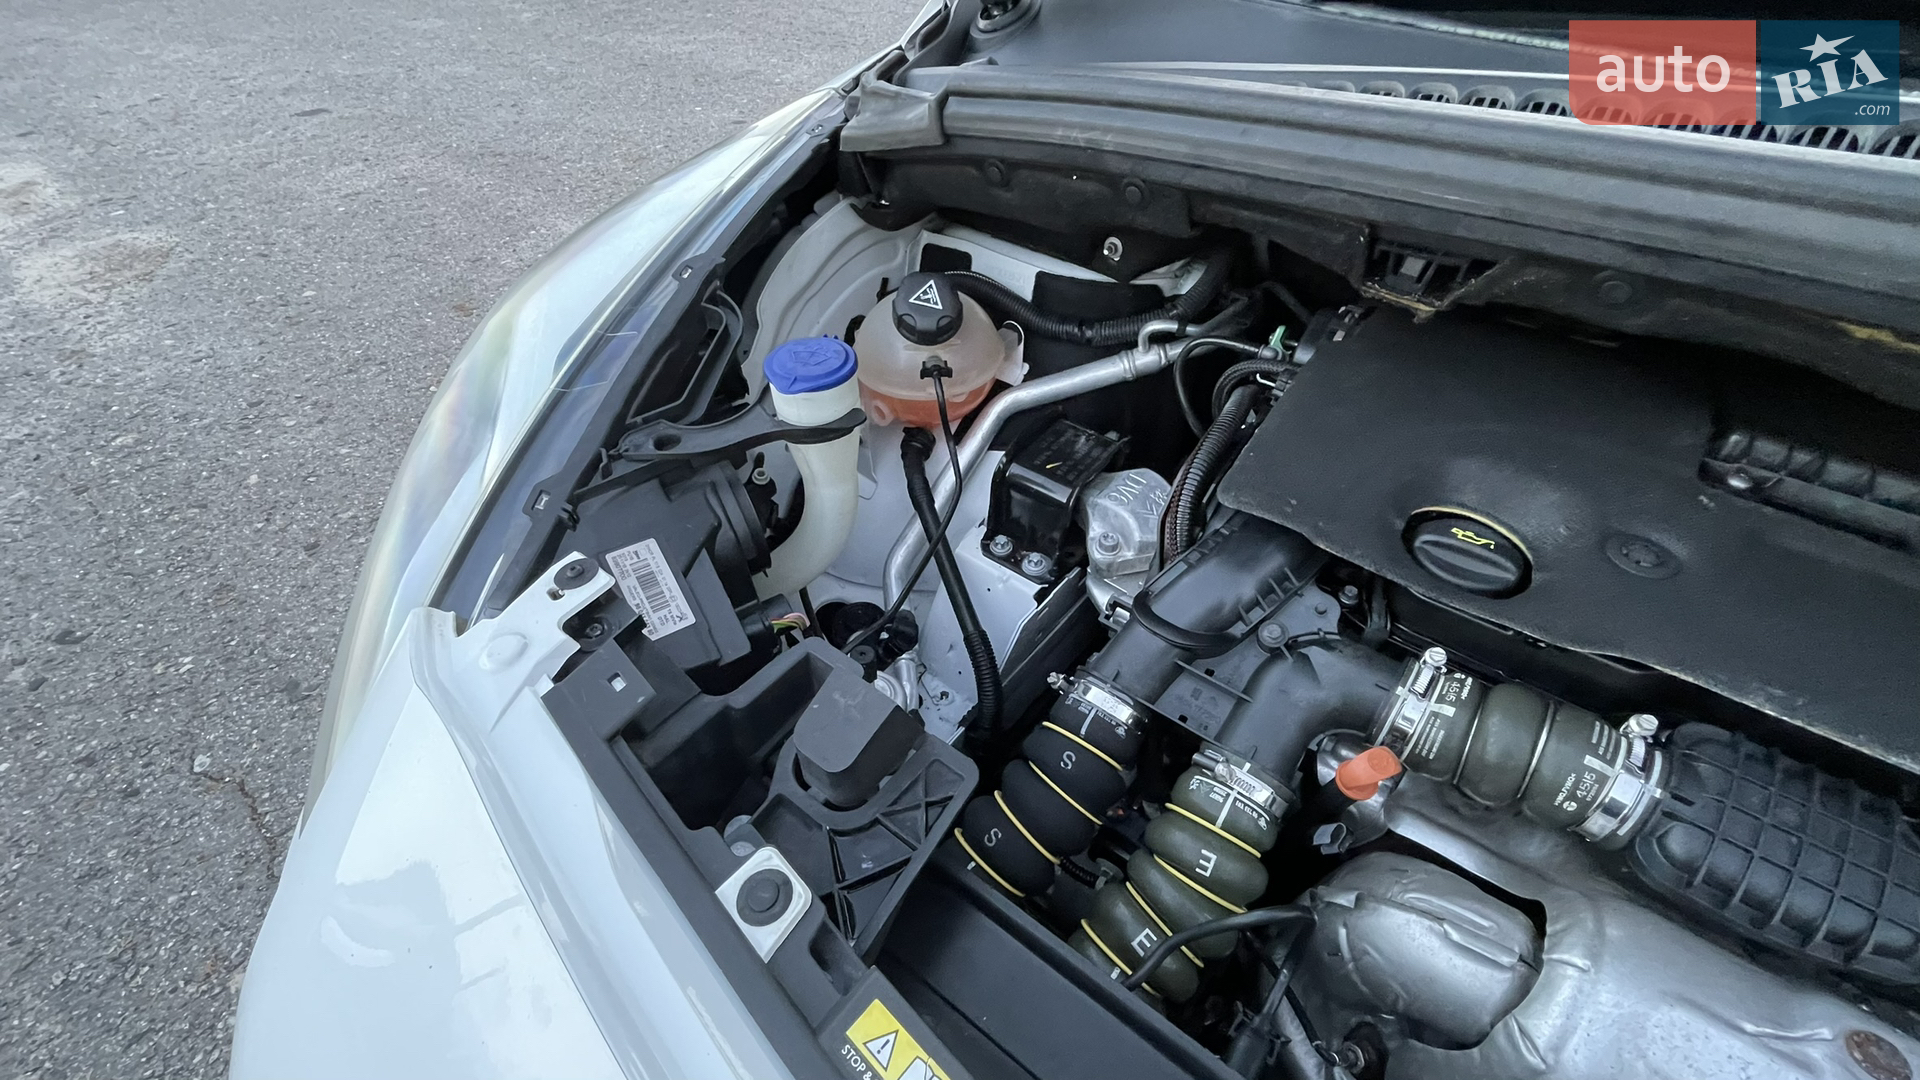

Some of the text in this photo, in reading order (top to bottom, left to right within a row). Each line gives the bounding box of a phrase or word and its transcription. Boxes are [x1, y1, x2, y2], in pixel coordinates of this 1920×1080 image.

[1060, 750, 1076, 770] S
[984, 827, 1001, 847] S
[1195, 849, 1218, 877] E
[1130, 927, 1158, 957] E
[841, 1044, 866, 1072] STOP
